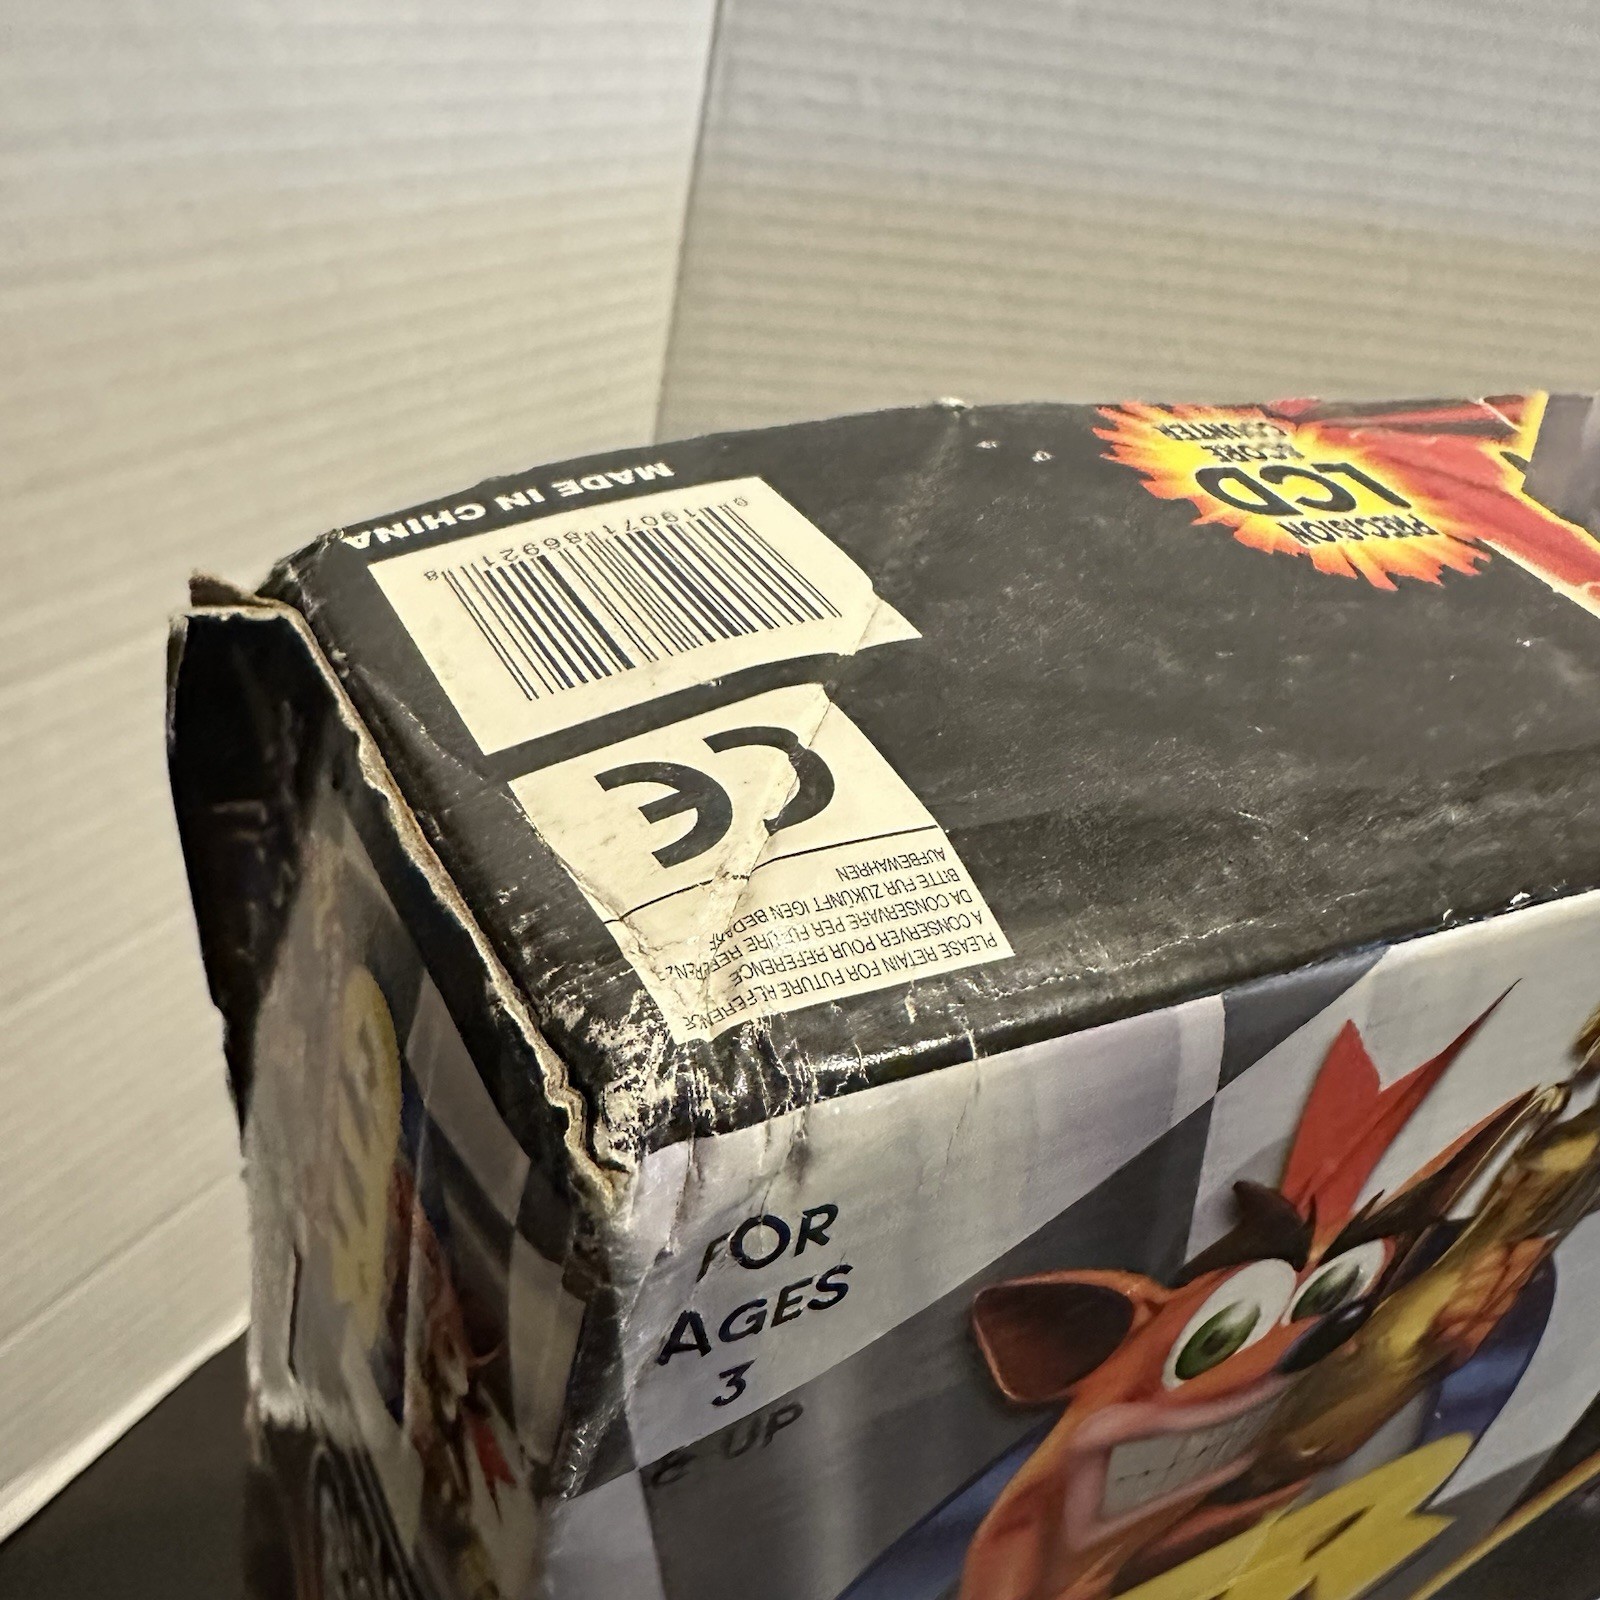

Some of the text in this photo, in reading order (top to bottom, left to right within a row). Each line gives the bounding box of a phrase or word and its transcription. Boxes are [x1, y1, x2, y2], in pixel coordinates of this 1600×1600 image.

[343, 461, 677, 550] MADE IN CHINA
[1195, 462, 1412, 516] LCD
[1277, 513, 1439, 546] PRECISION
[423, 570, 439, 582] 8
[593, 725, 835, 869] CE
[835, 847, 946, 882] AUFBEWAHREN
[916, 868, 961, 889] BITTE
[846, 894, 950, 930] CONSERVARE
[948, 889, 972, 905] DA
[810, 917, 846, 938] PER
[728, 910, 983, 987] A CONSERVER POUR REFERENCE
[881, 946, 938, 972] RETAIN
[937, 932, 998, 959] PLEASE
[777, 968, 846, 998] FUTURE
[846, 960, 881, 982] FOR
[696, 1203, 839, 1284] FOR
[655, 1264, 853, 1366] AGES
[711, 1358, 758, 1407] 3
[721, 1403, 804, 1459] UP
